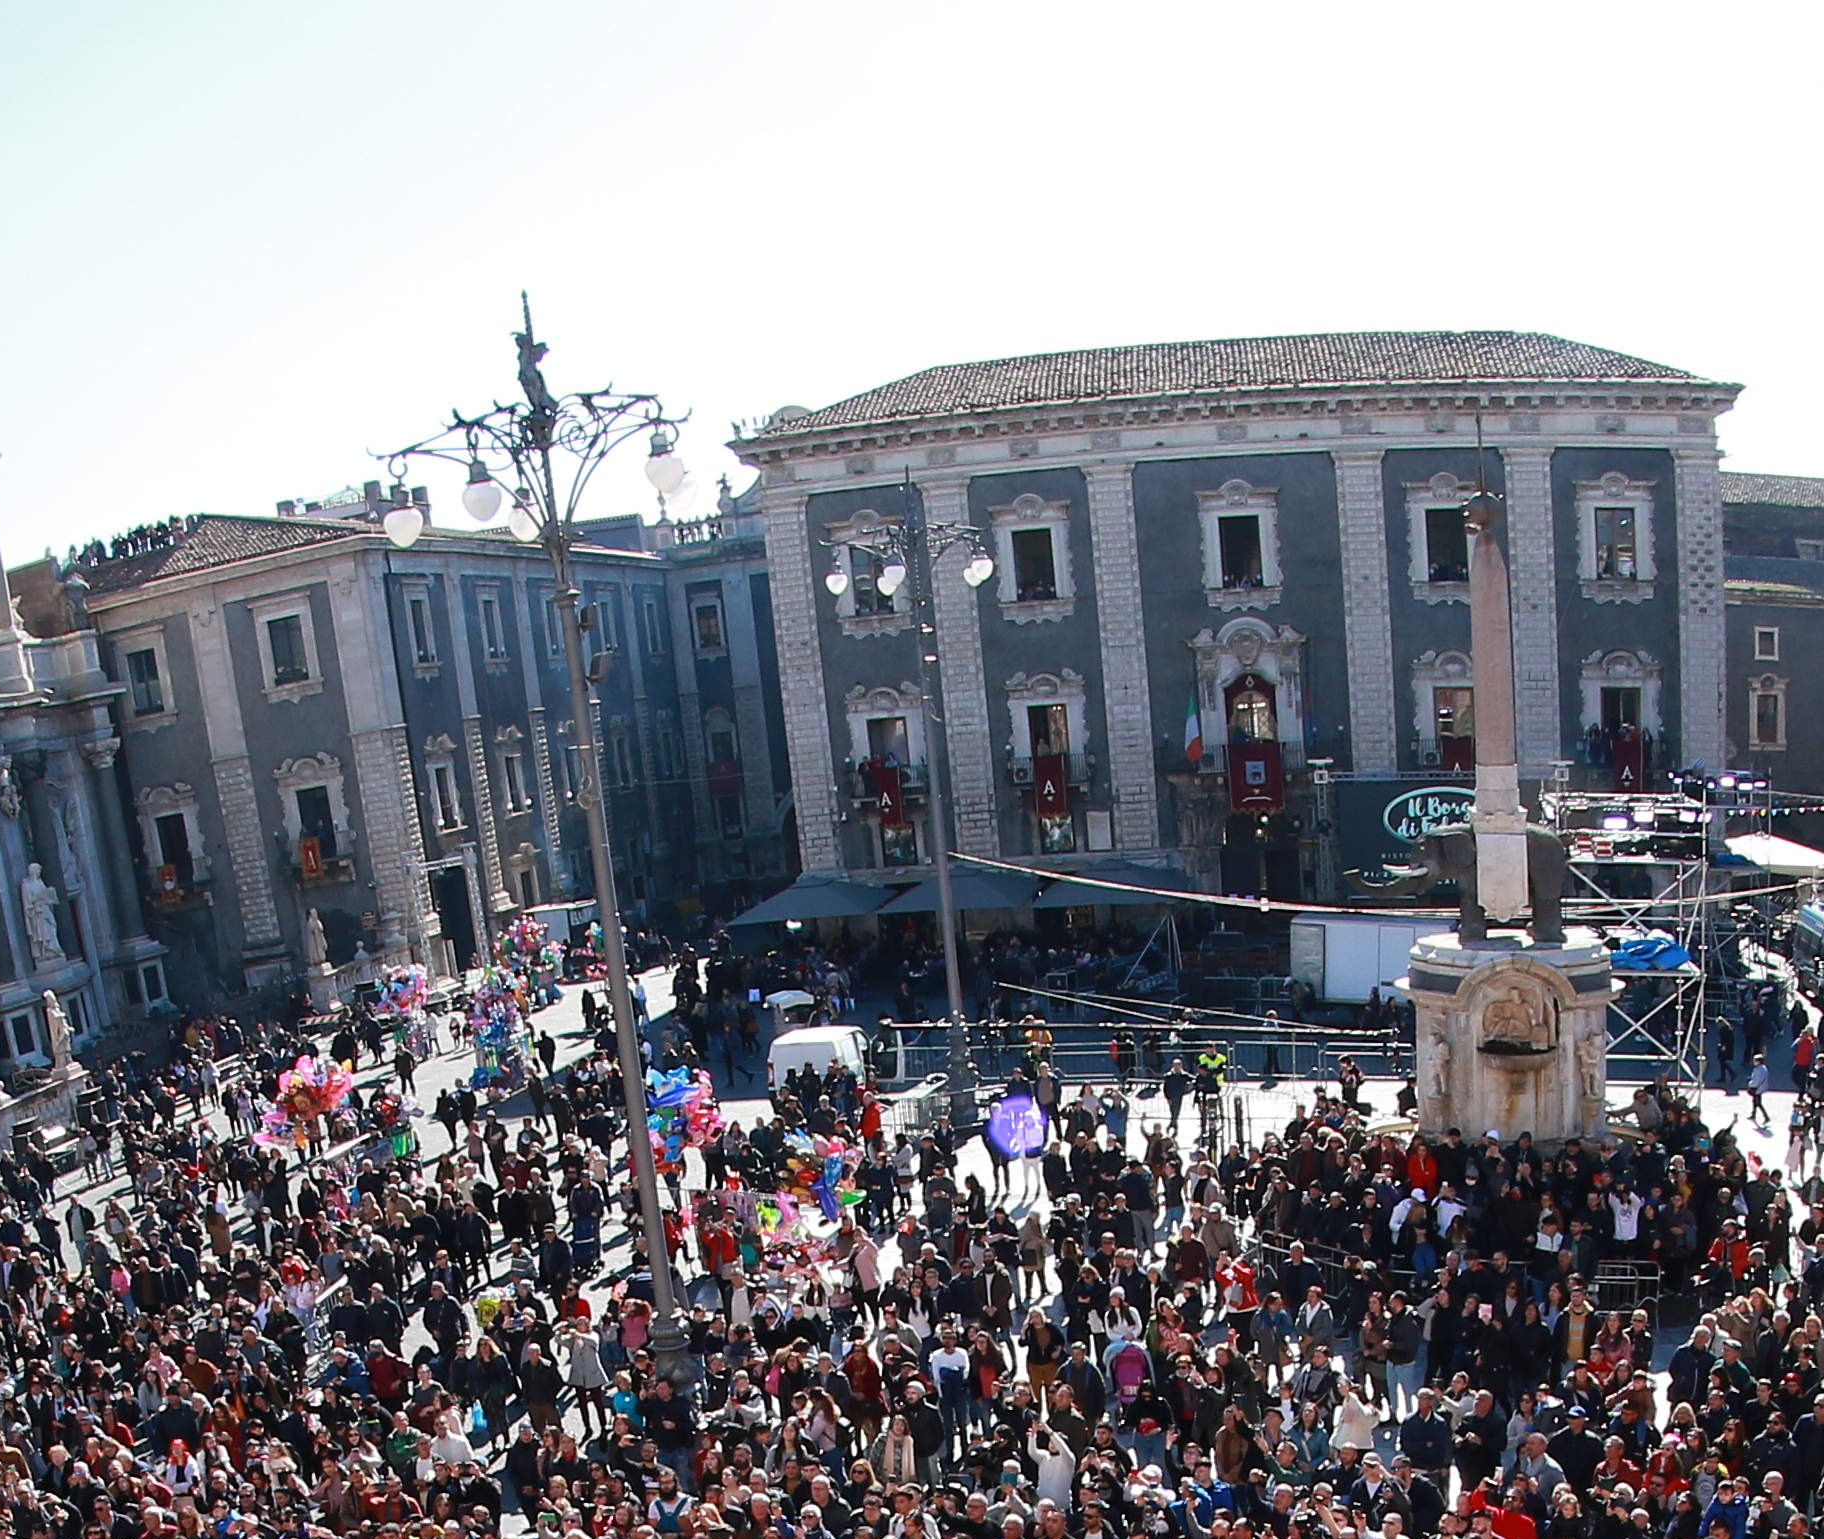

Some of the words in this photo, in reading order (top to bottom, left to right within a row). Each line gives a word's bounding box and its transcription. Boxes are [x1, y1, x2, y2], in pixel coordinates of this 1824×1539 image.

[1621, 765, 1634, 779] A
[1043, 780, 1056, 794] A
[881, 792, 893, 806] A
[1397, 817, 1420, 837] di
